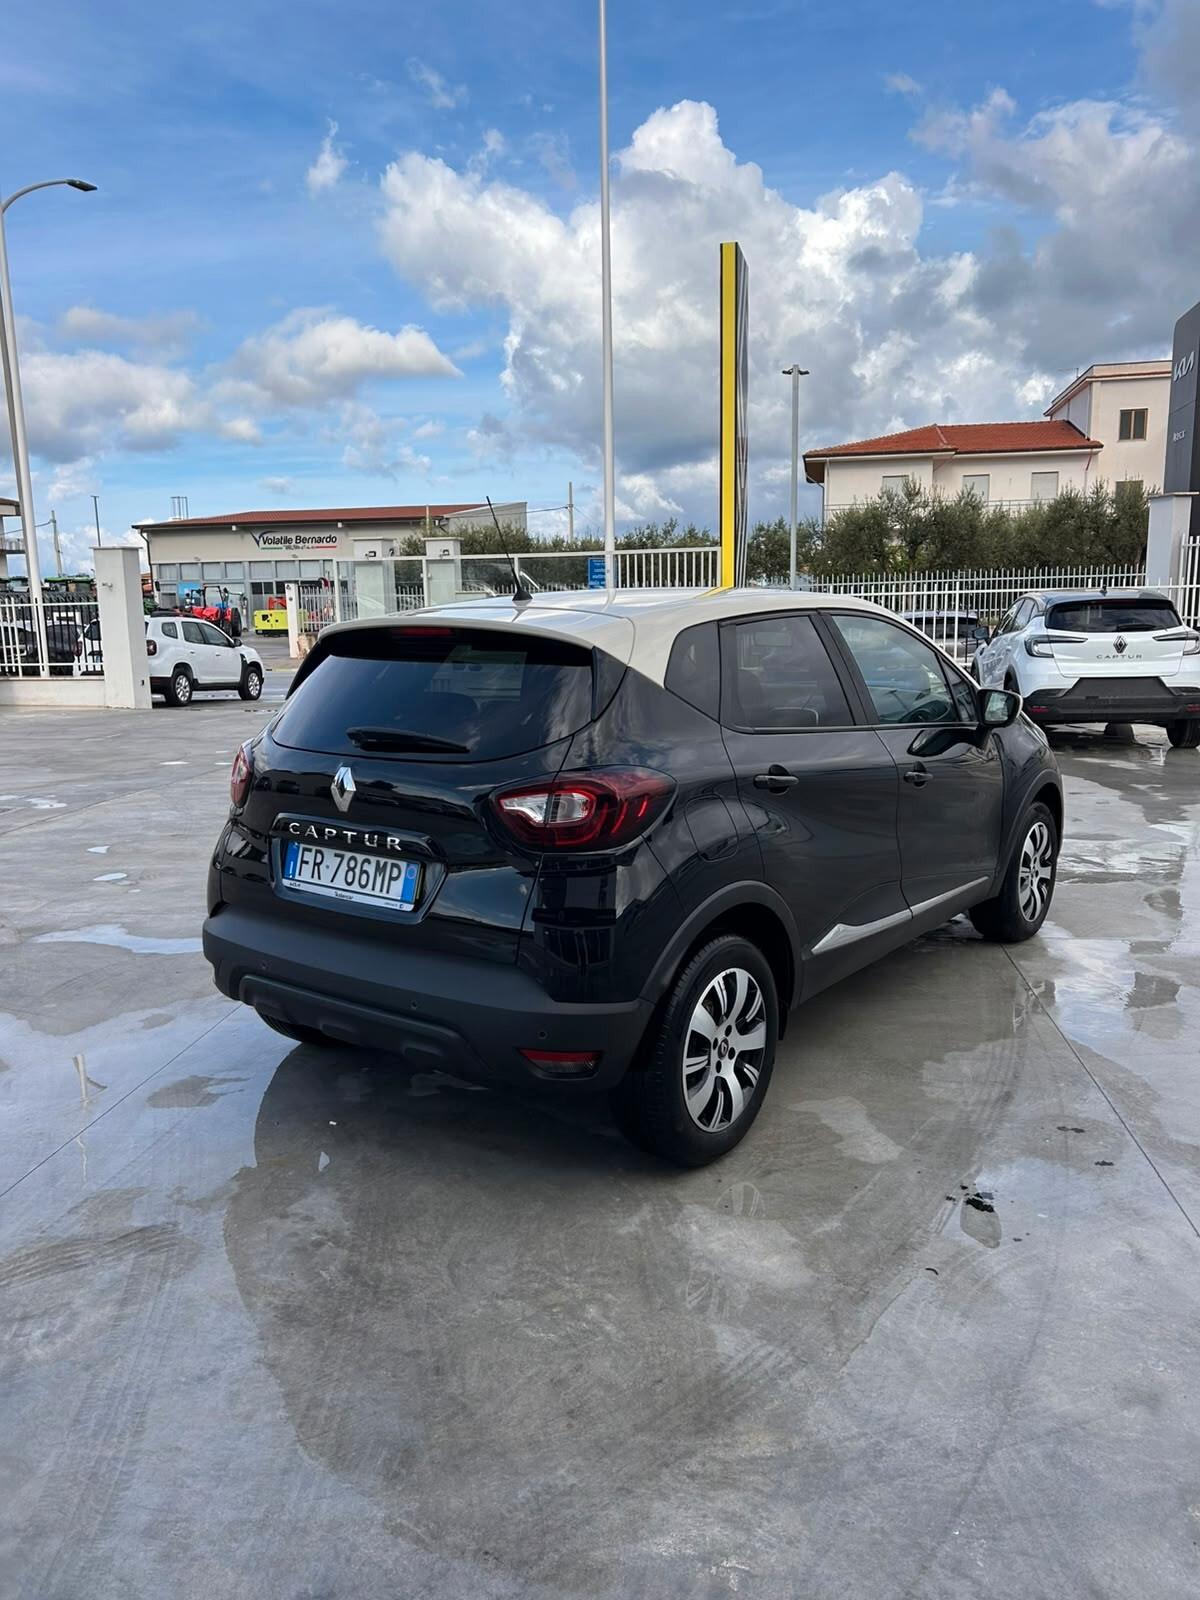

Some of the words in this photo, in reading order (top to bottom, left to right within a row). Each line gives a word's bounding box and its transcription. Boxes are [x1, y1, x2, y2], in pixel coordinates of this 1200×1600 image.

[1173, 350, 1195, 382] KIA
[262, 535, 294, 546] Volatile
[295, 534, 338, 545] Bernardo
[288, 822, 402, 851] CAPTUR
[330, 853, 403, 895] 786MP
